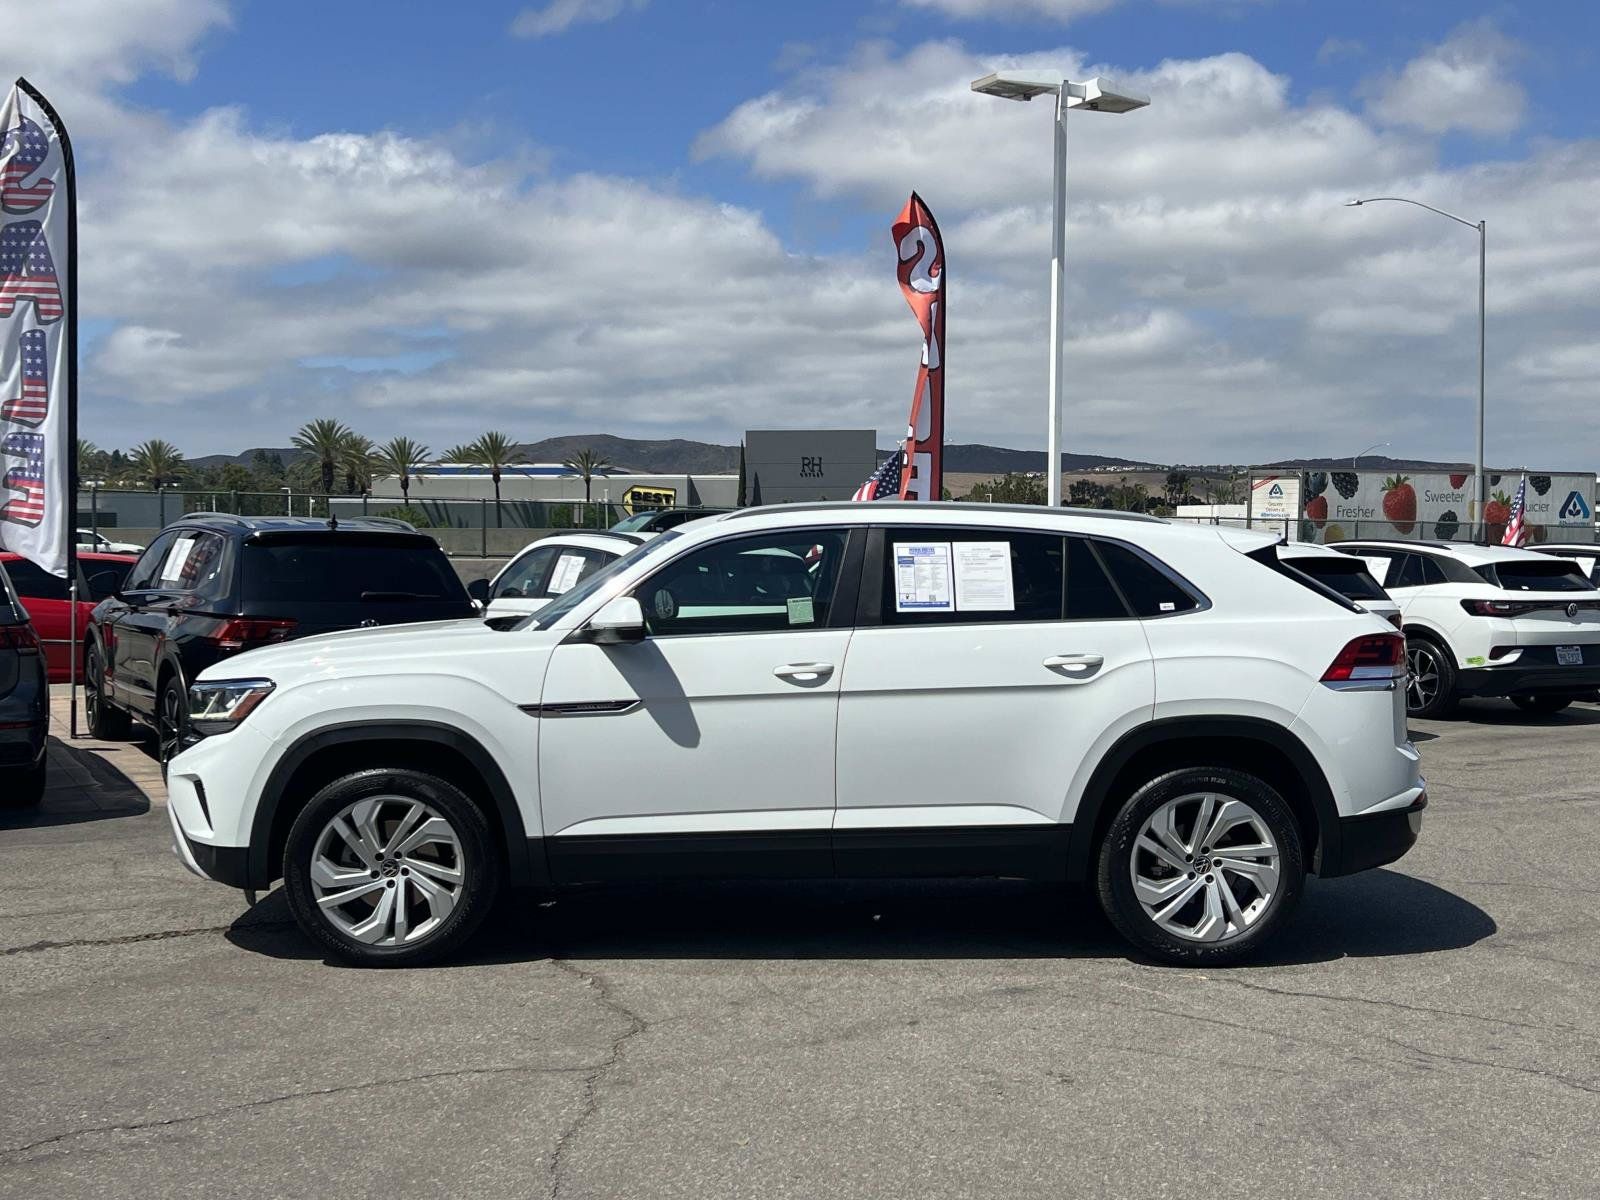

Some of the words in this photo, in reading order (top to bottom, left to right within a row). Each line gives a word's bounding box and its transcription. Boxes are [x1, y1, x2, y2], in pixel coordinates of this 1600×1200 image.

[801, 456, 822, 472] RH
[631, 491, 673, 504] BEST
[1424, 490, 1465, 502] Sweeter
[1336, 505, 1376, 518] Fresher
[1525, 503, 1550, 513] uicier
